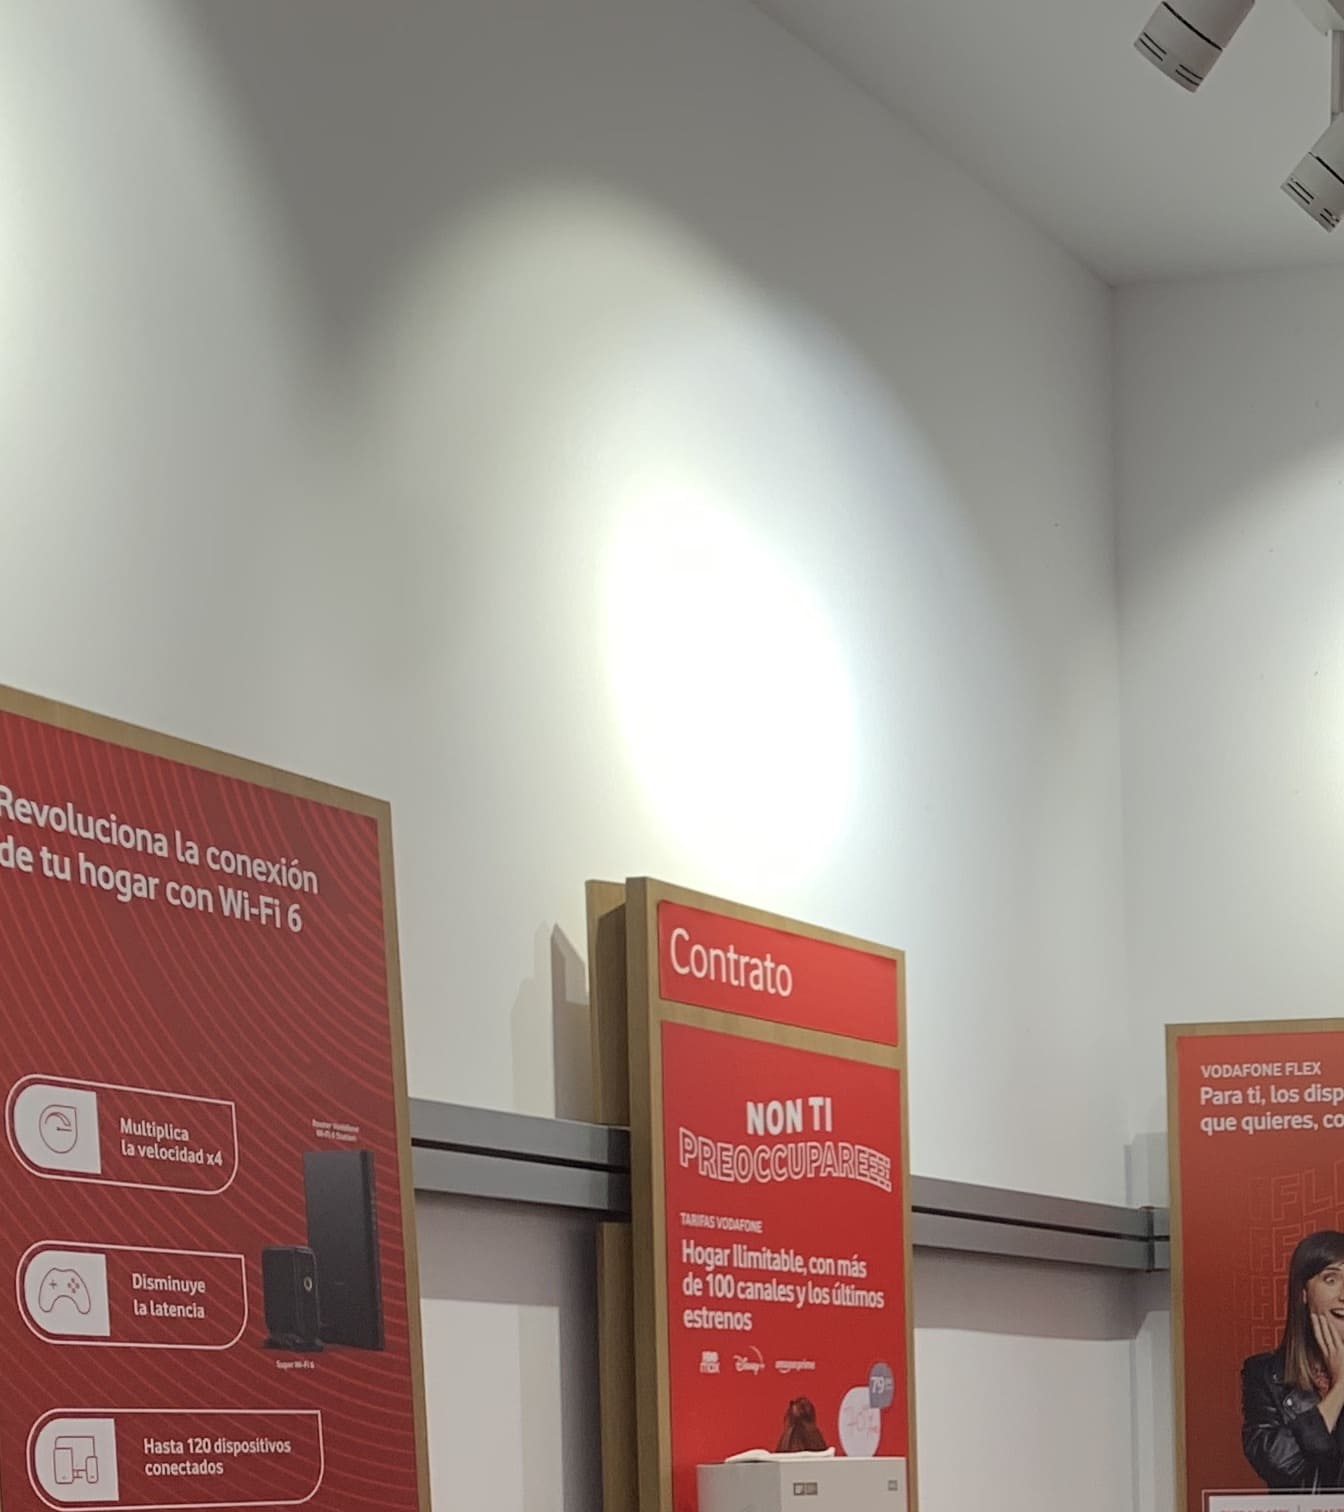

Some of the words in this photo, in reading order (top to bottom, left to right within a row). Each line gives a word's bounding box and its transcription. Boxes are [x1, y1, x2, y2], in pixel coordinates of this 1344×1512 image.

[0, 785, 168, 858] Revoluciona
[175, 830, 199, 866] la
[206, 846, 319, 895] conexión
[0, 835, 33, 873] de
[40, 846, 71, 882] tu
[79, 852, 159, 903] hogar
[166, 880, 214, 914] con
[218, 885, 281, 929] Wi-Fi
[287, 904, 302, 933] 6
[670, 927, 793, 997] Contrato
[1200, 1063, 1282, 1078] VODAFONE
[1285, 1061, 1321, 1076] FLEX
[1200, 1086, 1242, 1105] Para
[1247, 1085, 1265, 1106] ti,
[1270, 1084, 1299, 1103] los
[747, 1098, 803, 1136] NON
[808, 1096, 832, 1132] TI
[1200, 1115, 1237, 1135] que
[1241, 1111, 1319, 1134] quieres,
[120, 1117, 189, 1142] Multiplica
[121, 1139, 135, 1156] la
[137, 1144, 204, 1164] velocidad
[206, 1151, 223, 1167] x4
[680, 1212, 715, 1229] TARIFAS
[716, 1216, 763, 1234] VODAFONE
[681, 1239, 730, 1271] Hogar
[733, 1244, 807, 1276] Ilimitable,
[809, 1256, 836, 1275] con
[837, 1254, 867, 1279] más
[132, 1273, 206, 1295] Disminuye
[682, 1272, 703, 1296] de
[705, 1273, 735, 1299] 100
[737, 1278, 795, 1303] canales
[795, 1286, 807, 1309] y
[808, 1281, 830, 1305] los
[832, 1282, 885, 1309] últimos
[134, 1299, 147, 1316] la
[150, 1300, 205, 1319] latencia
[683, 1306, 753, 1331] estrenos
[144, 1438, 184, 1455] Hasta
[187, 1438, 212, 1454] 120
[214, 1437, 292, 1456] dispositivos
[145, 1459, 224, 1476] conectados
